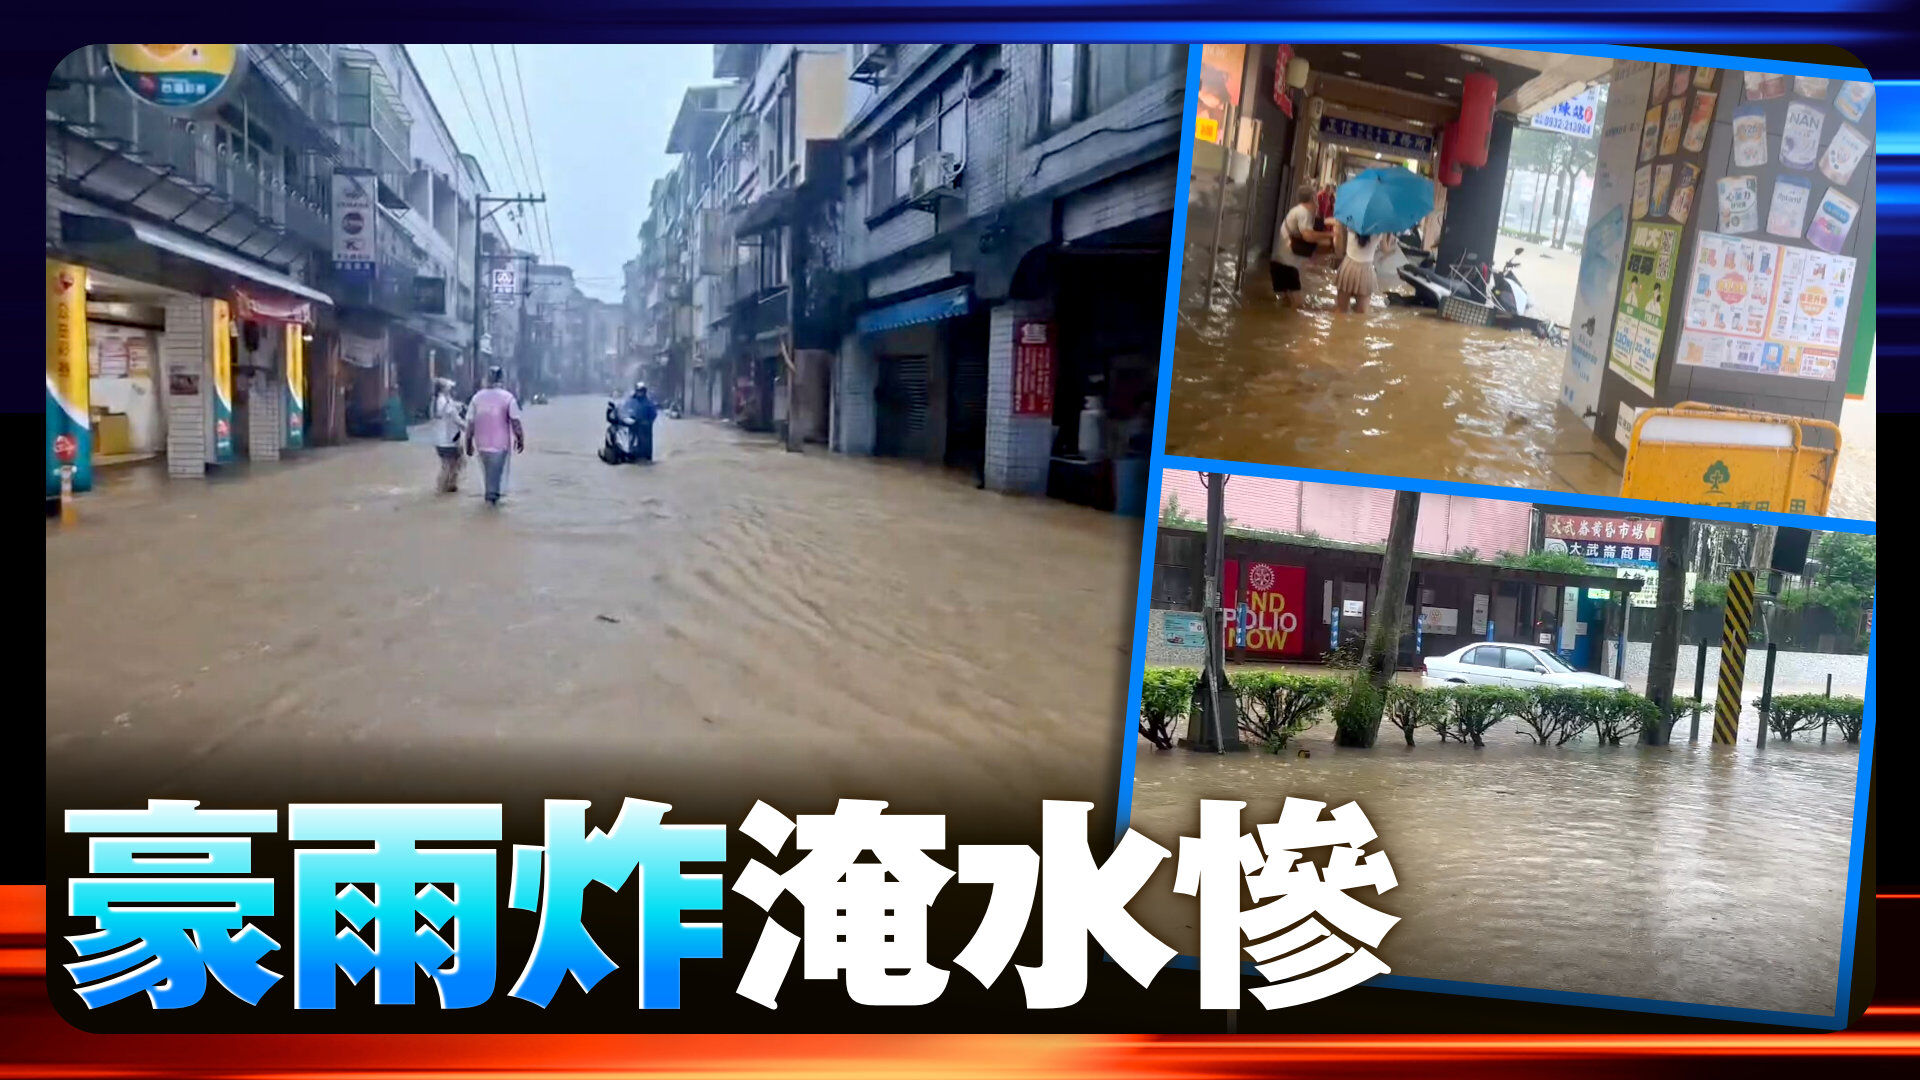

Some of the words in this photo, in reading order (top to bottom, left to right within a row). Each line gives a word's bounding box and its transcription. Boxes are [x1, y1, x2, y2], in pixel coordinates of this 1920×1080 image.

[1788, 113, 1820, 129] NAN
[1021, 323, 1047, 344] 售
[1569, 541, 1653, 561] 大武崙商圈
[1223, 606, 1298, 633] POLIO
